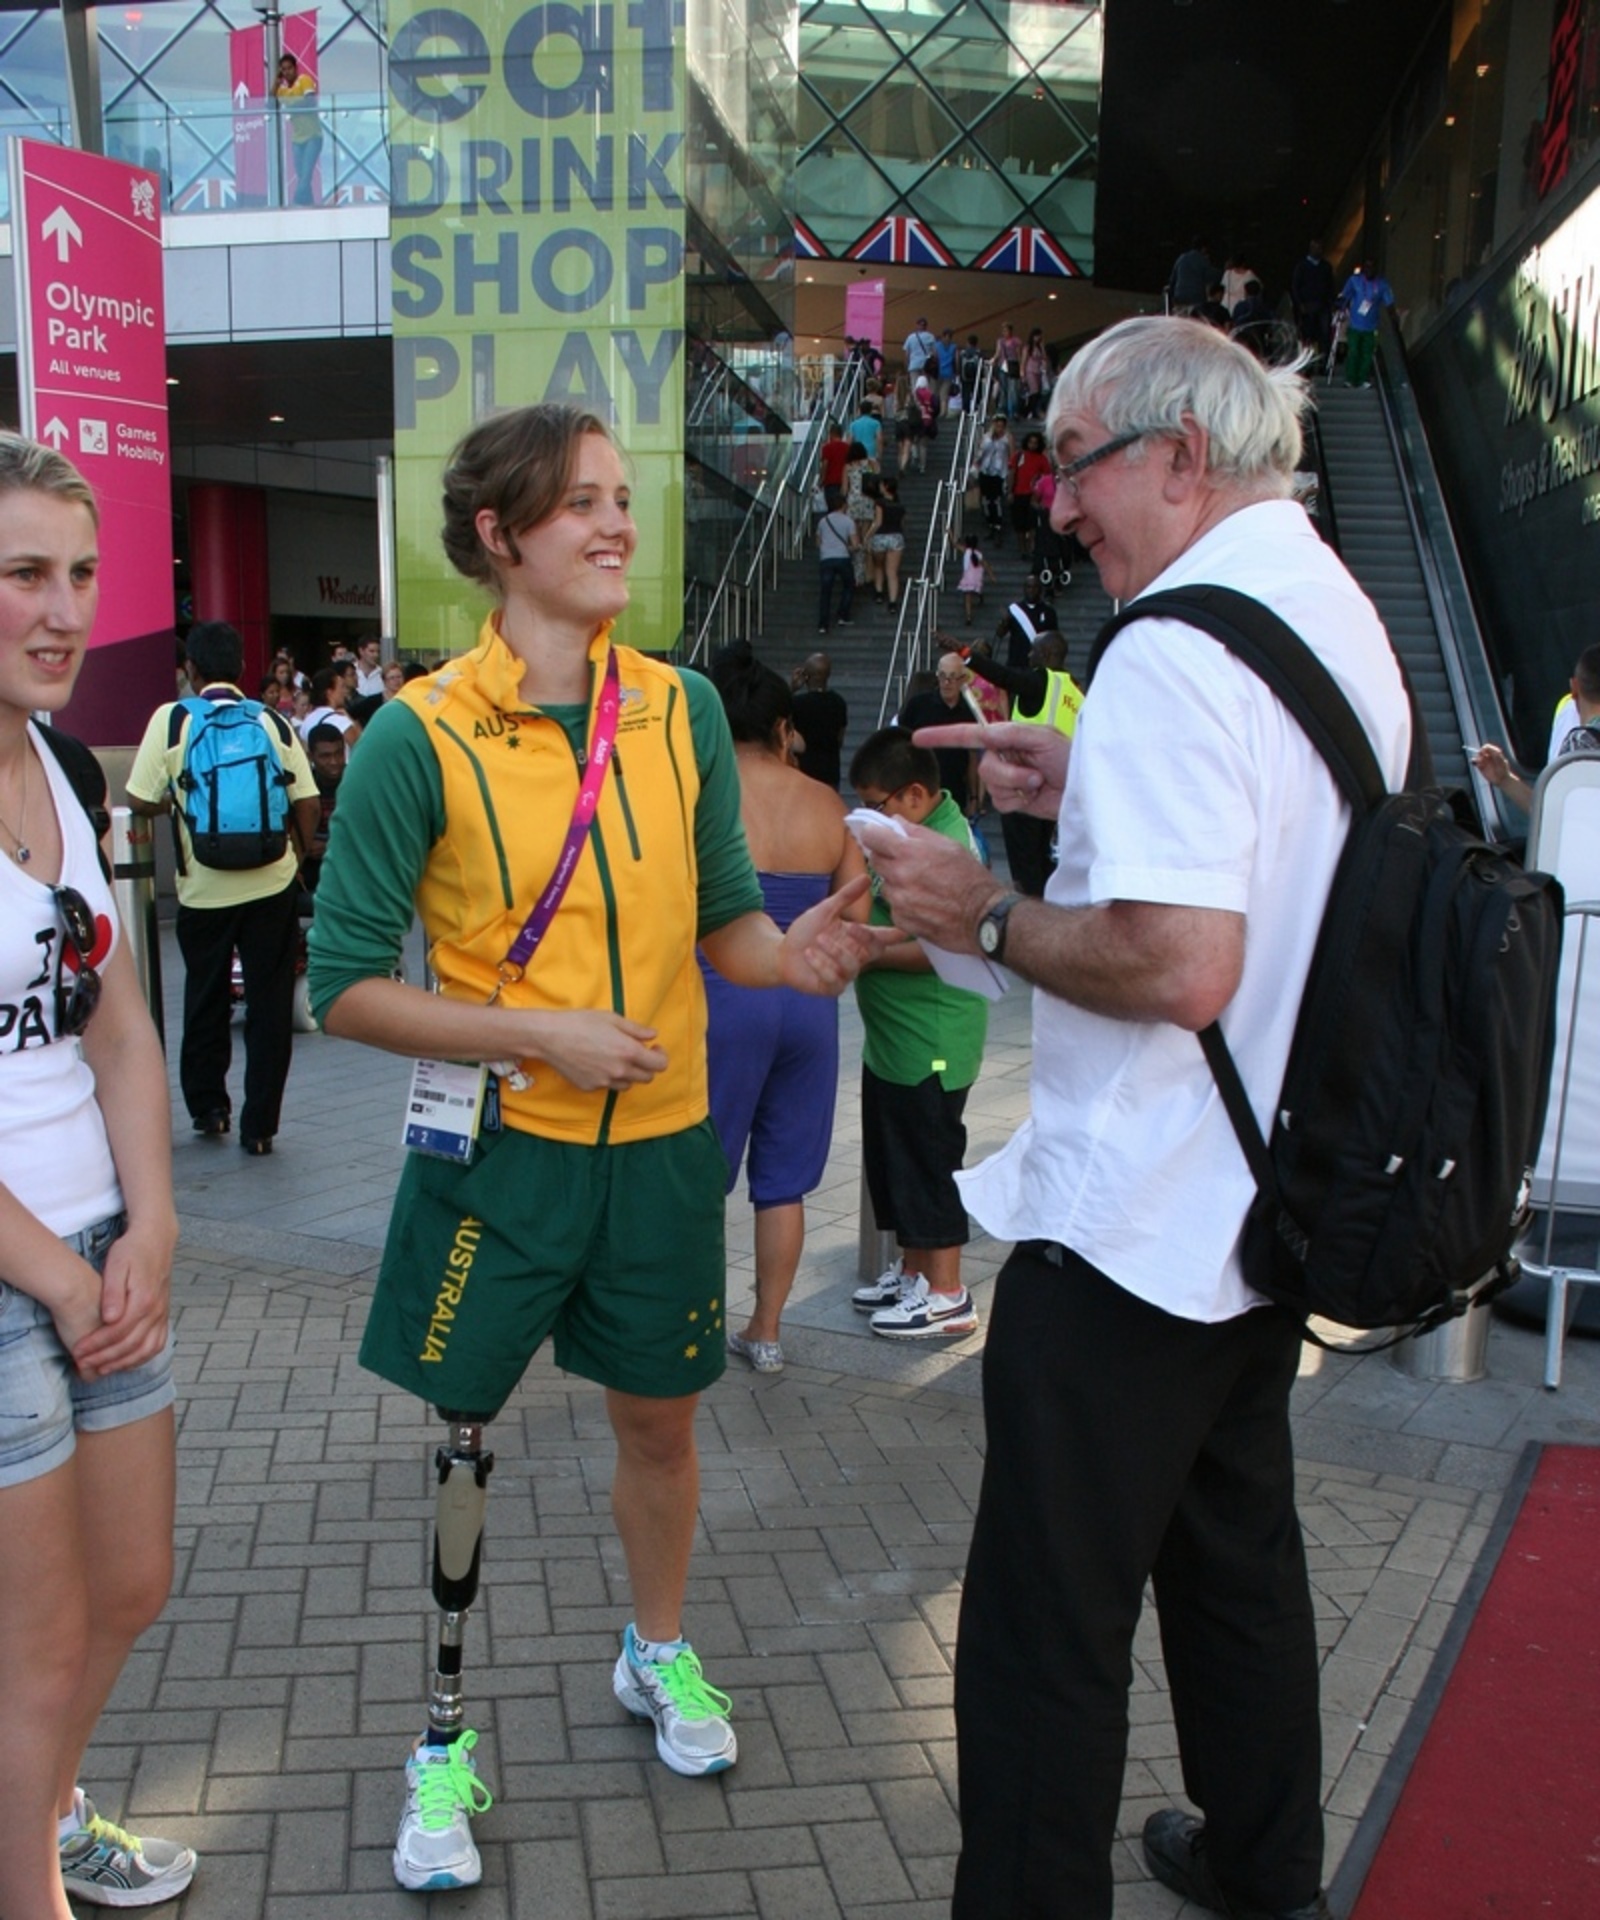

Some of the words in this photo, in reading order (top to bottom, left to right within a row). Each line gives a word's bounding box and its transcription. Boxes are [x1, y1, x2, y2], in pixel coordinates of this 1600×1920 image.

[388, 0, 686, 124] eat
[389, 133, 686, 218] DRINK
[391, 227, 684, 319] SHOP
[46, 281, 155, 328] Olympic
[48, 318, 108, 353] Park
[49, 359, 70, 375] All
[74, 365, 121, 382] venues
[394, 330, 684, 430] PLAY
[116, 423, 157, 442] Games
[117, 443, 165, 465] Mobility
[317, 575, 377, 607] Westfield
[26, 927, 56, 990] I
